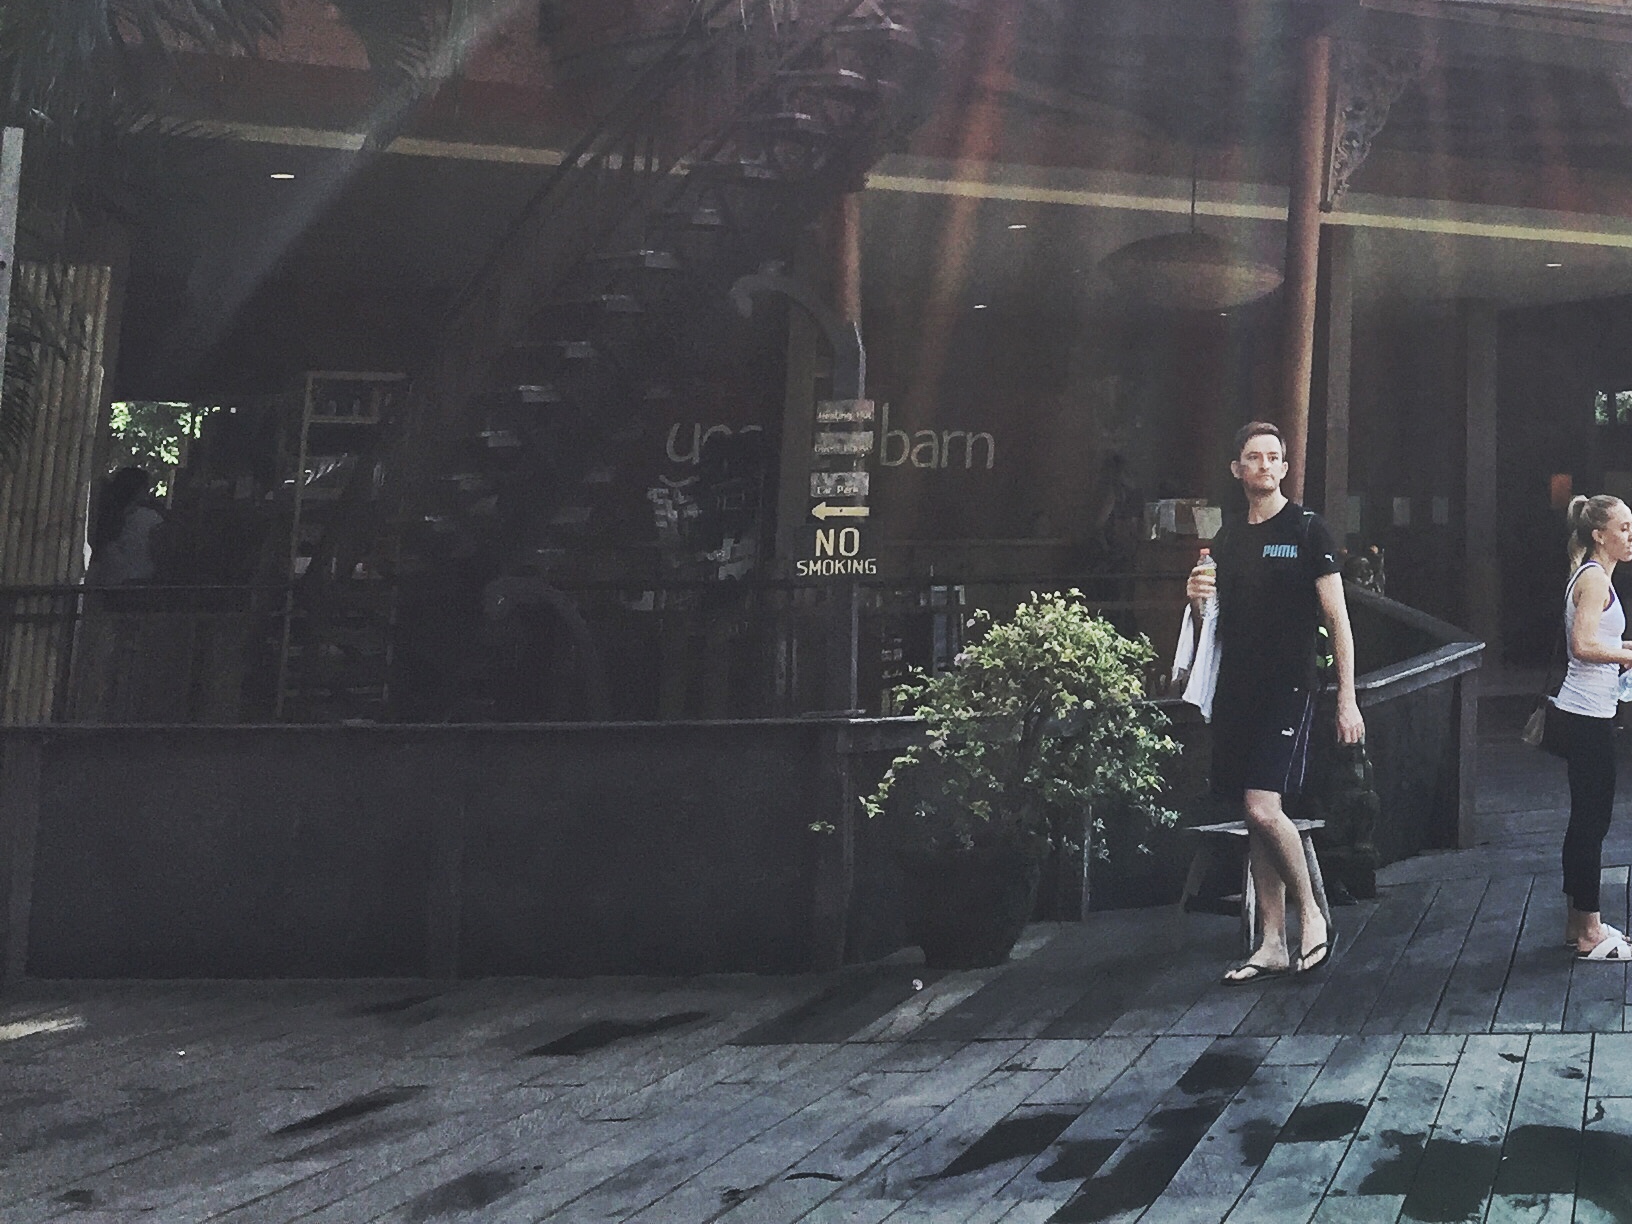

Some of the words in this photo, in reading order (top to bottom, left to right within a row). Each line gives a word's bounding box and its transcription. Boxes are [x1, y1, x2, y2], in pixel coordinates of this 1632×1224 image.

[880, 402, 995, 469] barn
[815, 527, 860, 556] NO
[1262, 544, 1298, 559] PUMA
[796, 558, 877, 576] SMOKING
